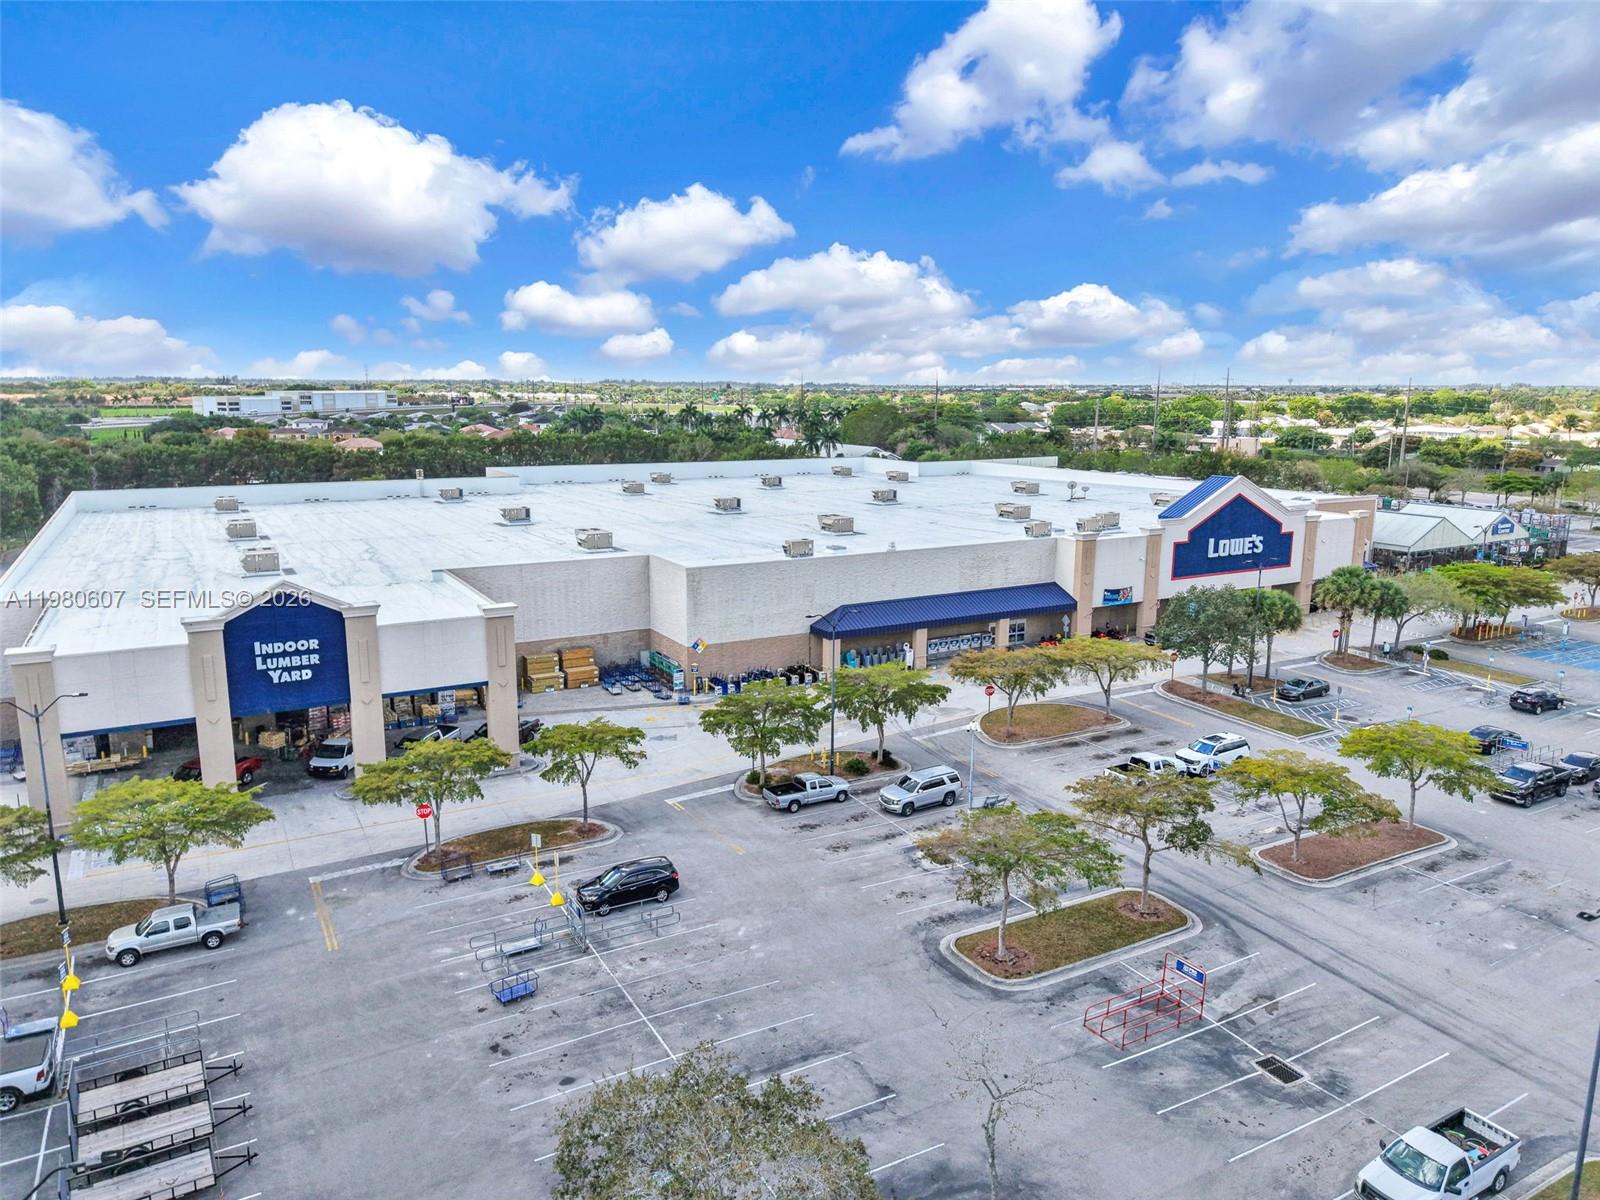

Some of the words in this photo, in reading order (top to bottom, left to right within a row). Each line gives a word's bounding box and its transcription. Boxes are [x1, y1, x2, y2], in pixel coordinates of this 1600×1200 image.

[1208, 534, 1263, 558] LOWE'S
[254, 638, 319, 655] INDOOR
[255, 653, 320, 670] LUMBER
[267, 668, 312, 684] YARD
[416, 807, 432, 816] STOP
